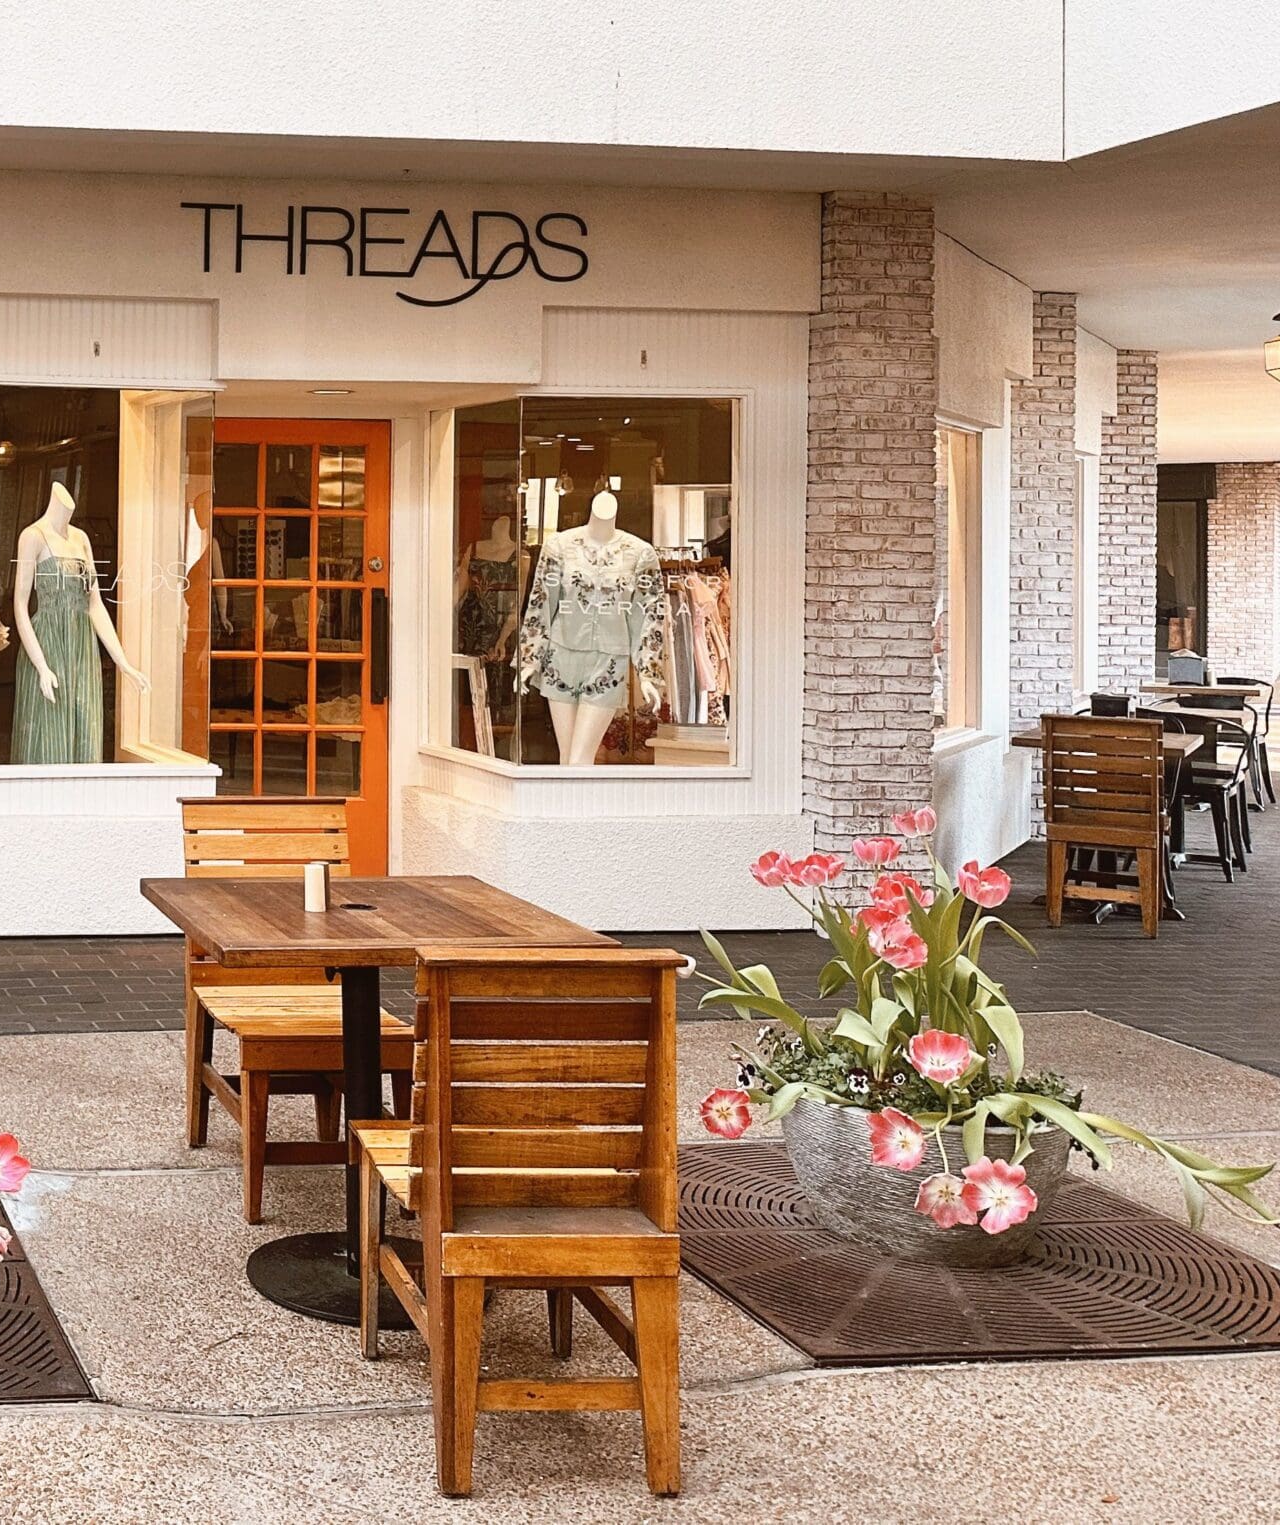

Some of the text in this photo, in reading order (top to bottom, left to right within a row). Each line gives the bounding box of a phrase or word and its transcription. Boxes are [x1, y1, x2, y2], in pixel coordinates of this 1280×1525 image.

[180, 201, 589, 307] THREADS
[667, 574, 721, 590] FOR
[559, 600, 708, 617] EVERYDAY
